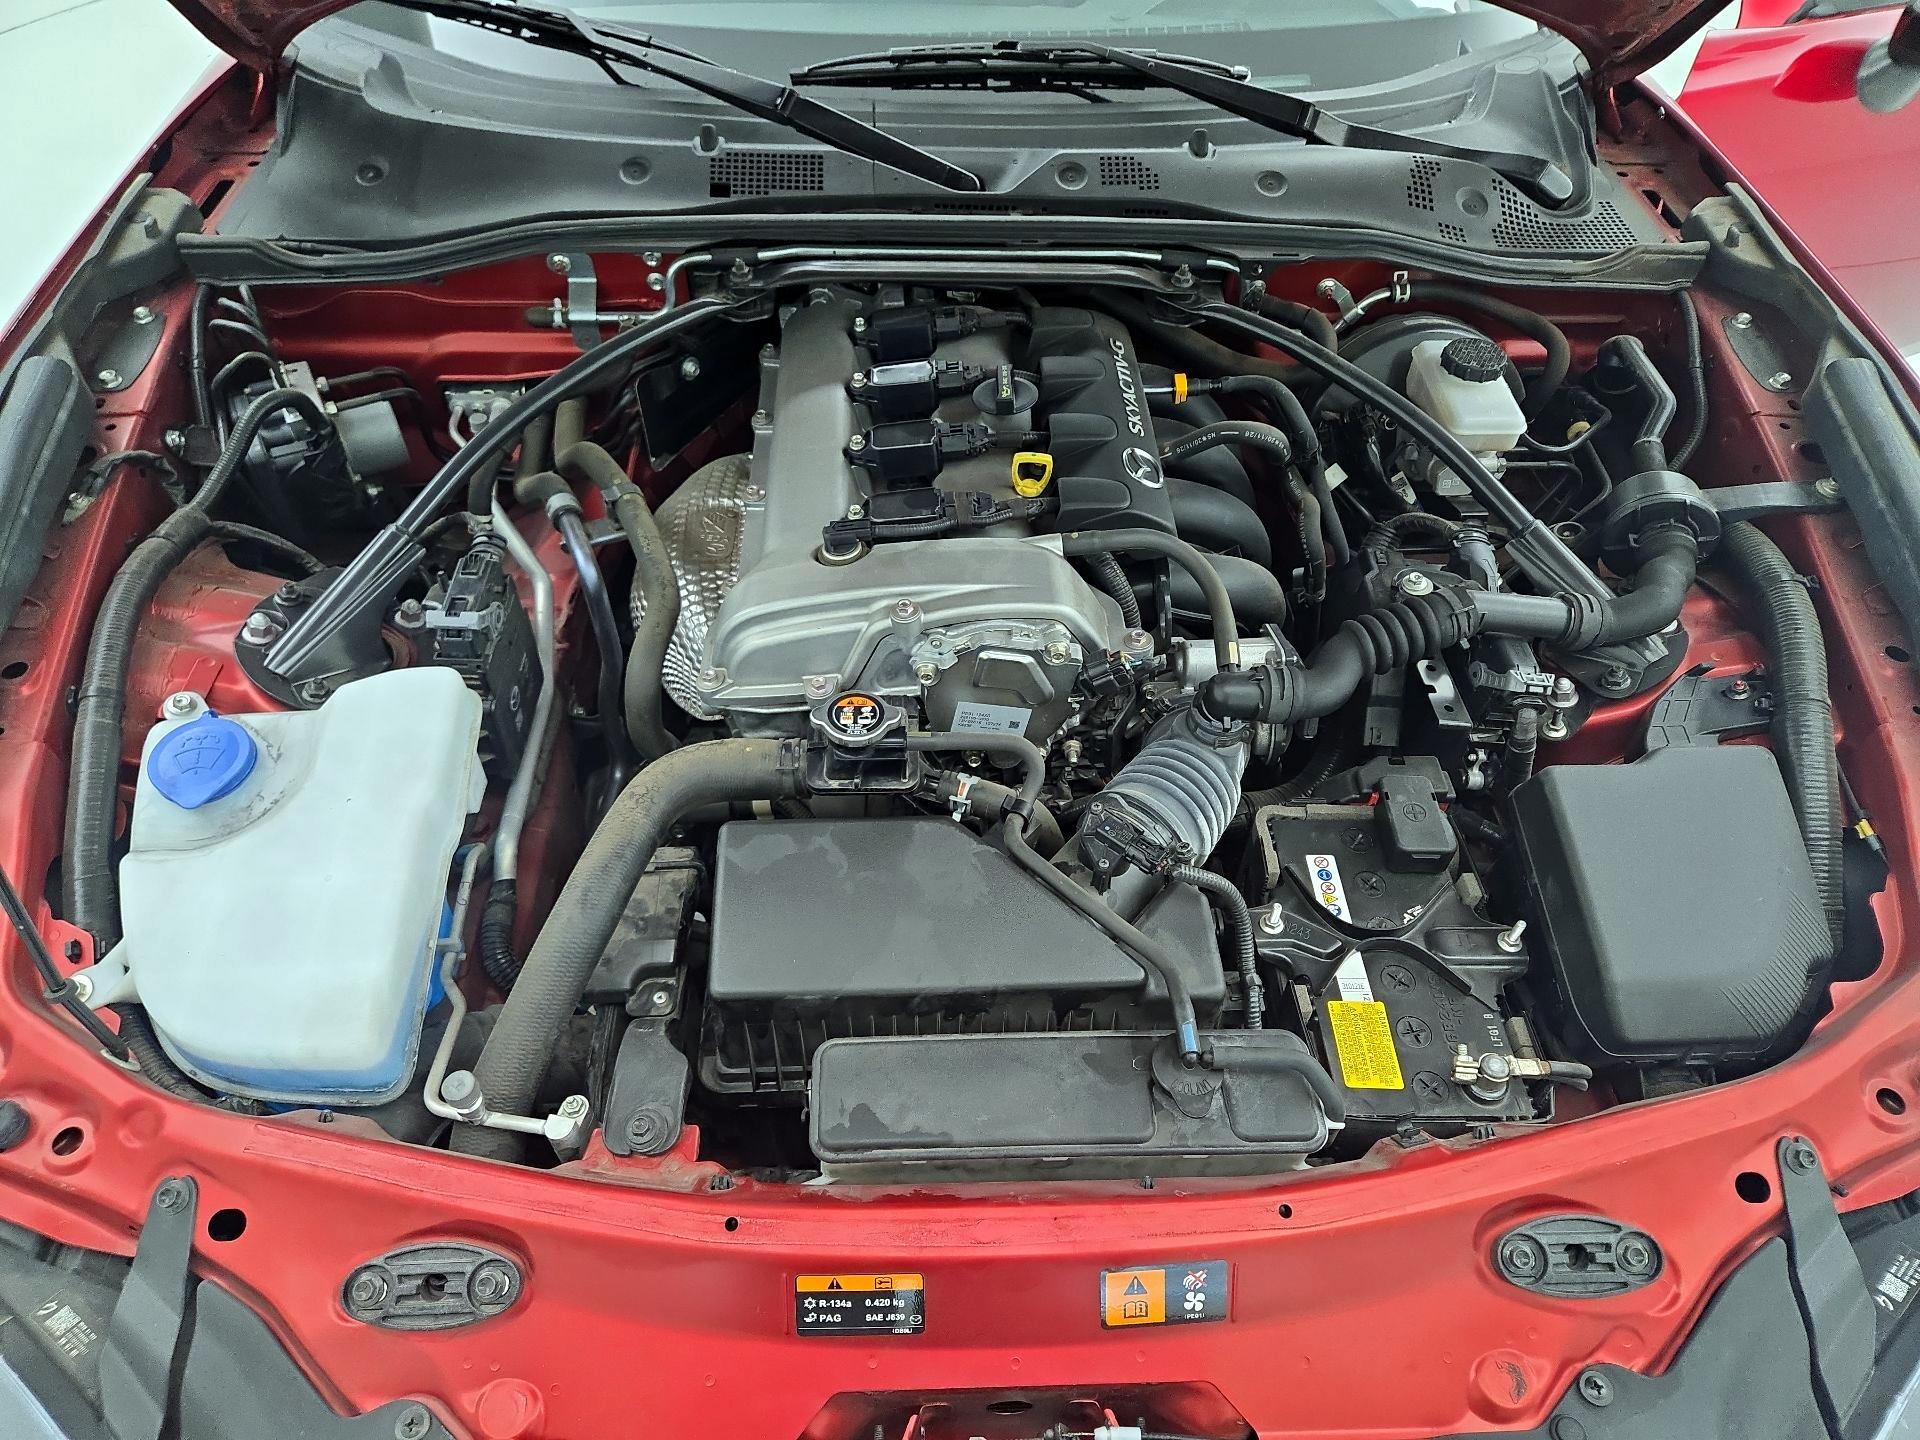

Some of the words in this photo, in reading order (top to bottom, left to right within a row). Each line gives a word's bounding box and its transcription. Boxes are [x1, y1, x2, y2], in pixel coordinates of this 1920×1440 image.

[1109, 337, 1145, 437] SKYACTIV-G
[818, 1299, 852, 1308] R-134a
[865, 1298, 890, 1307] 0.420
[892, 1298, 905, 1308] kg
[819, 1314, 842, 1323] PAG
[865, 1313, 884, 1321] SAE
[885, 1313, 906, 1321] J639
